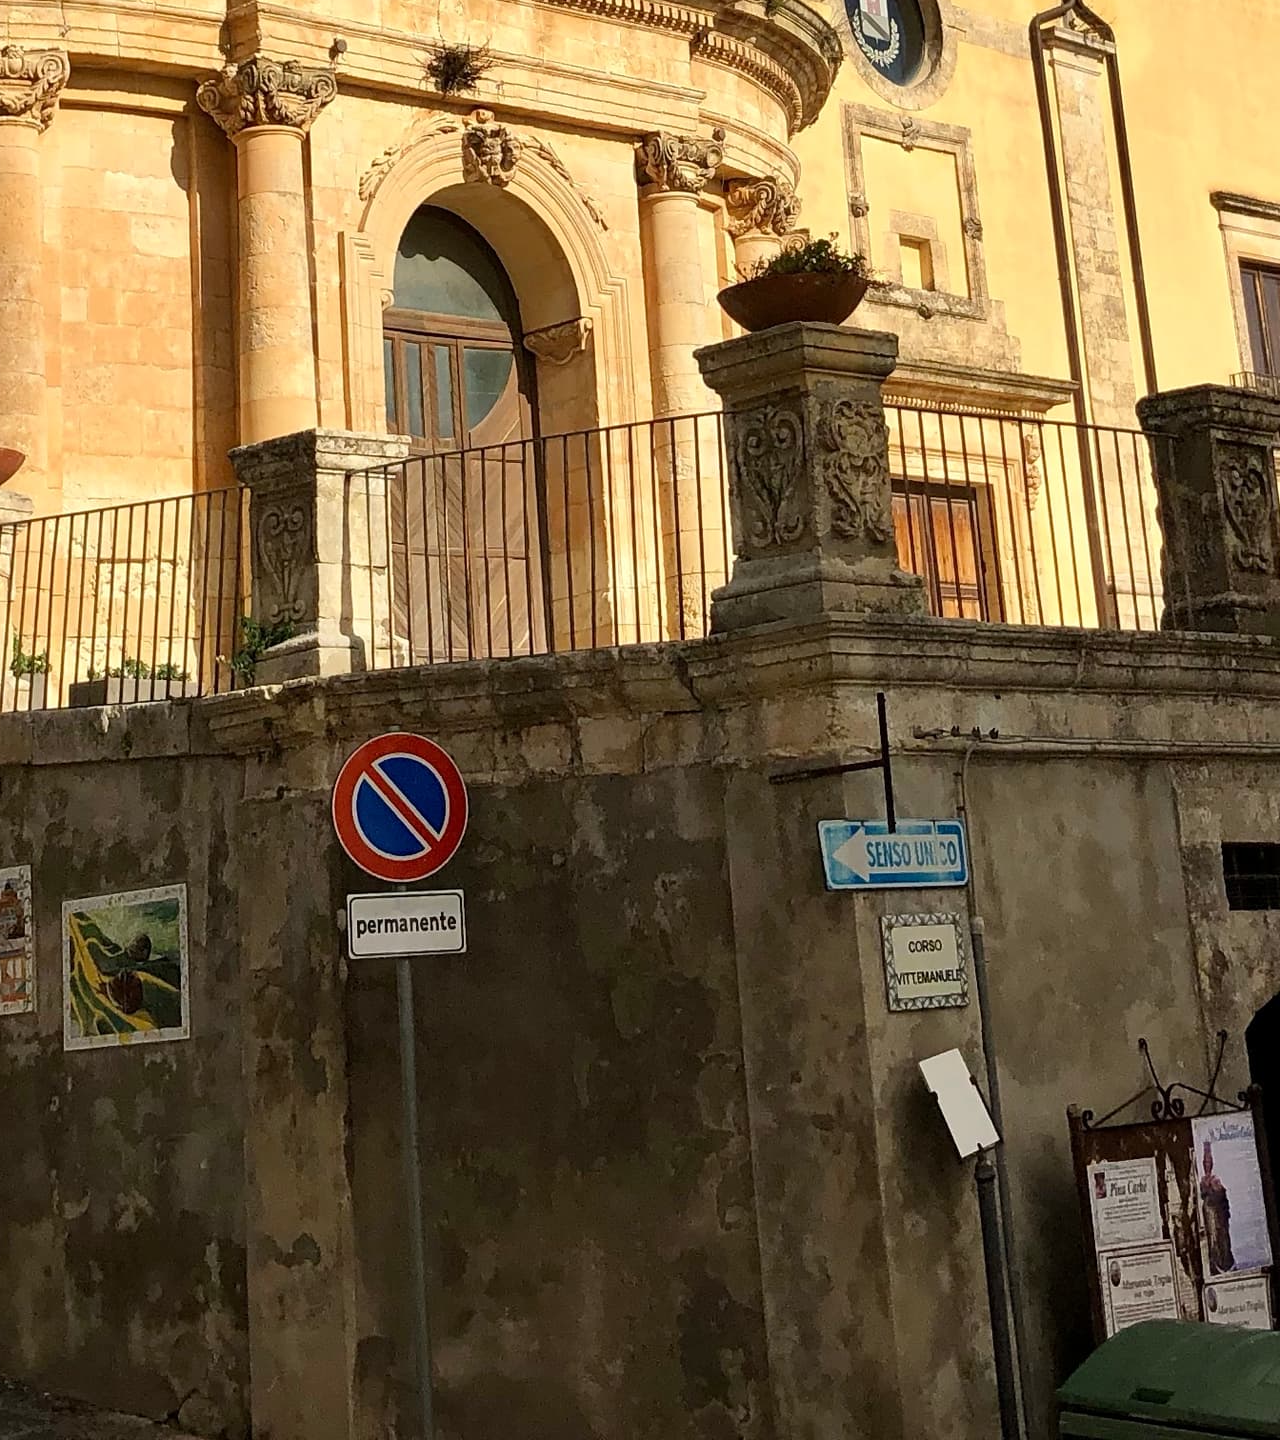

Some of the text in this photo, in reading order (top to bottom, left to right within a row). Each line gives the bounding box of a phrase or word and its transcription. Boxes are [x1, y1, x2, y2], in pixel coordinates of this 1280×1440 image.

[866, 841, 912, 867] SENSO
[356, 912, 456, 938] permanente
[908, 939, 942, 953] CORSO
